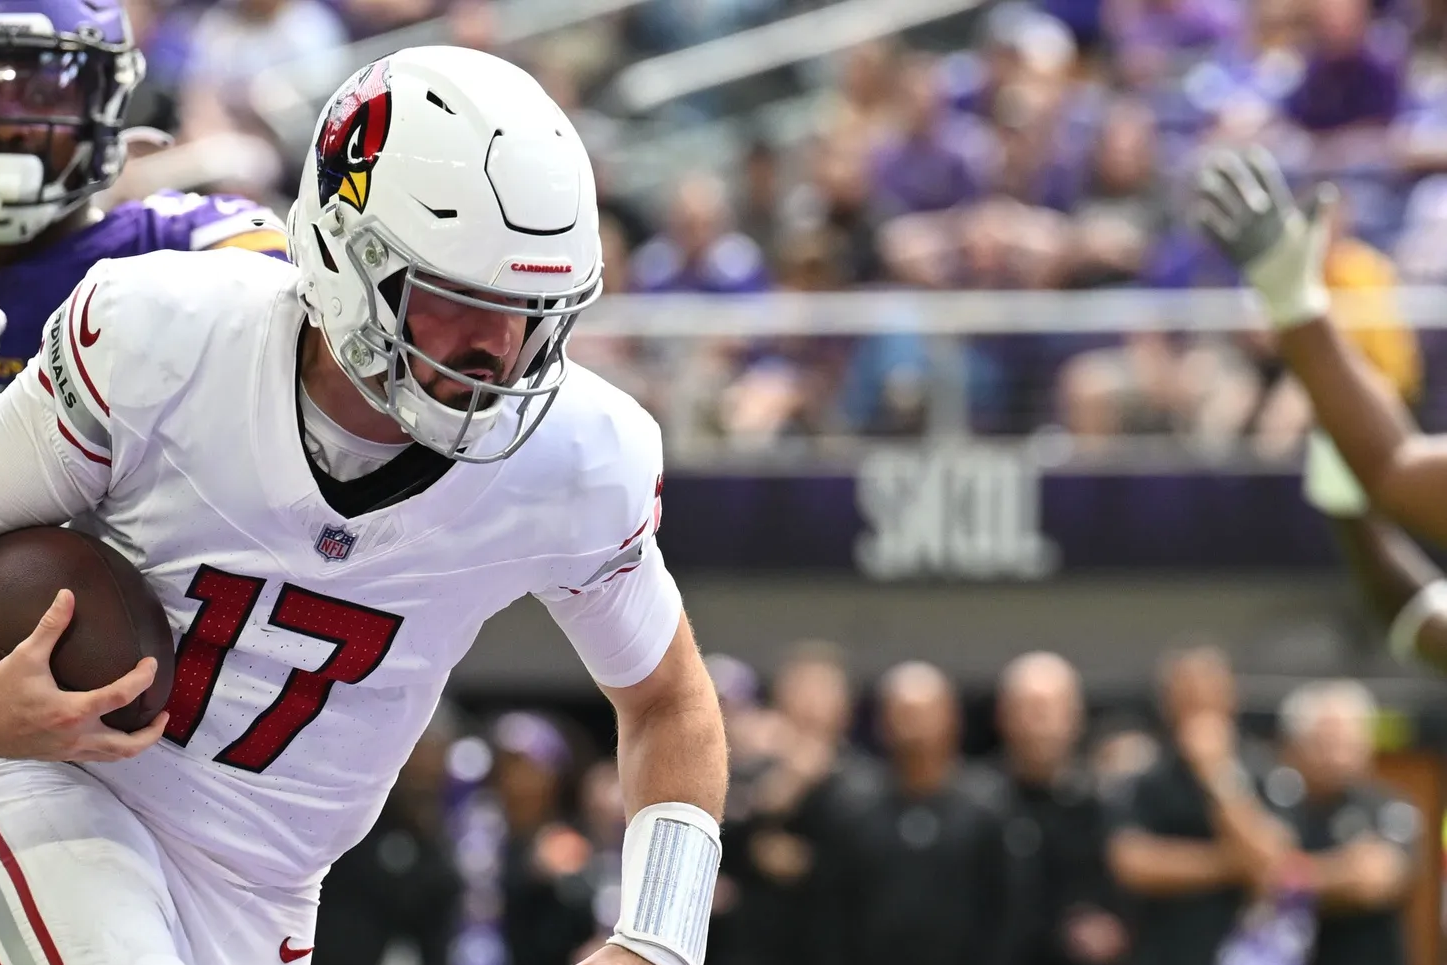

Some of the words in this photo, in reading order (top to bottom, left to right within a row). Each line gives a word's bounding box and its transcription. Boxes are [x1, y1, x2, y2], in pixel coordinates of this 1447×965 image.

[510, 263, 572, 274] CARDINALS
[320, 537, 345, 558] NFL
[161, 563, 405, 775] 17
